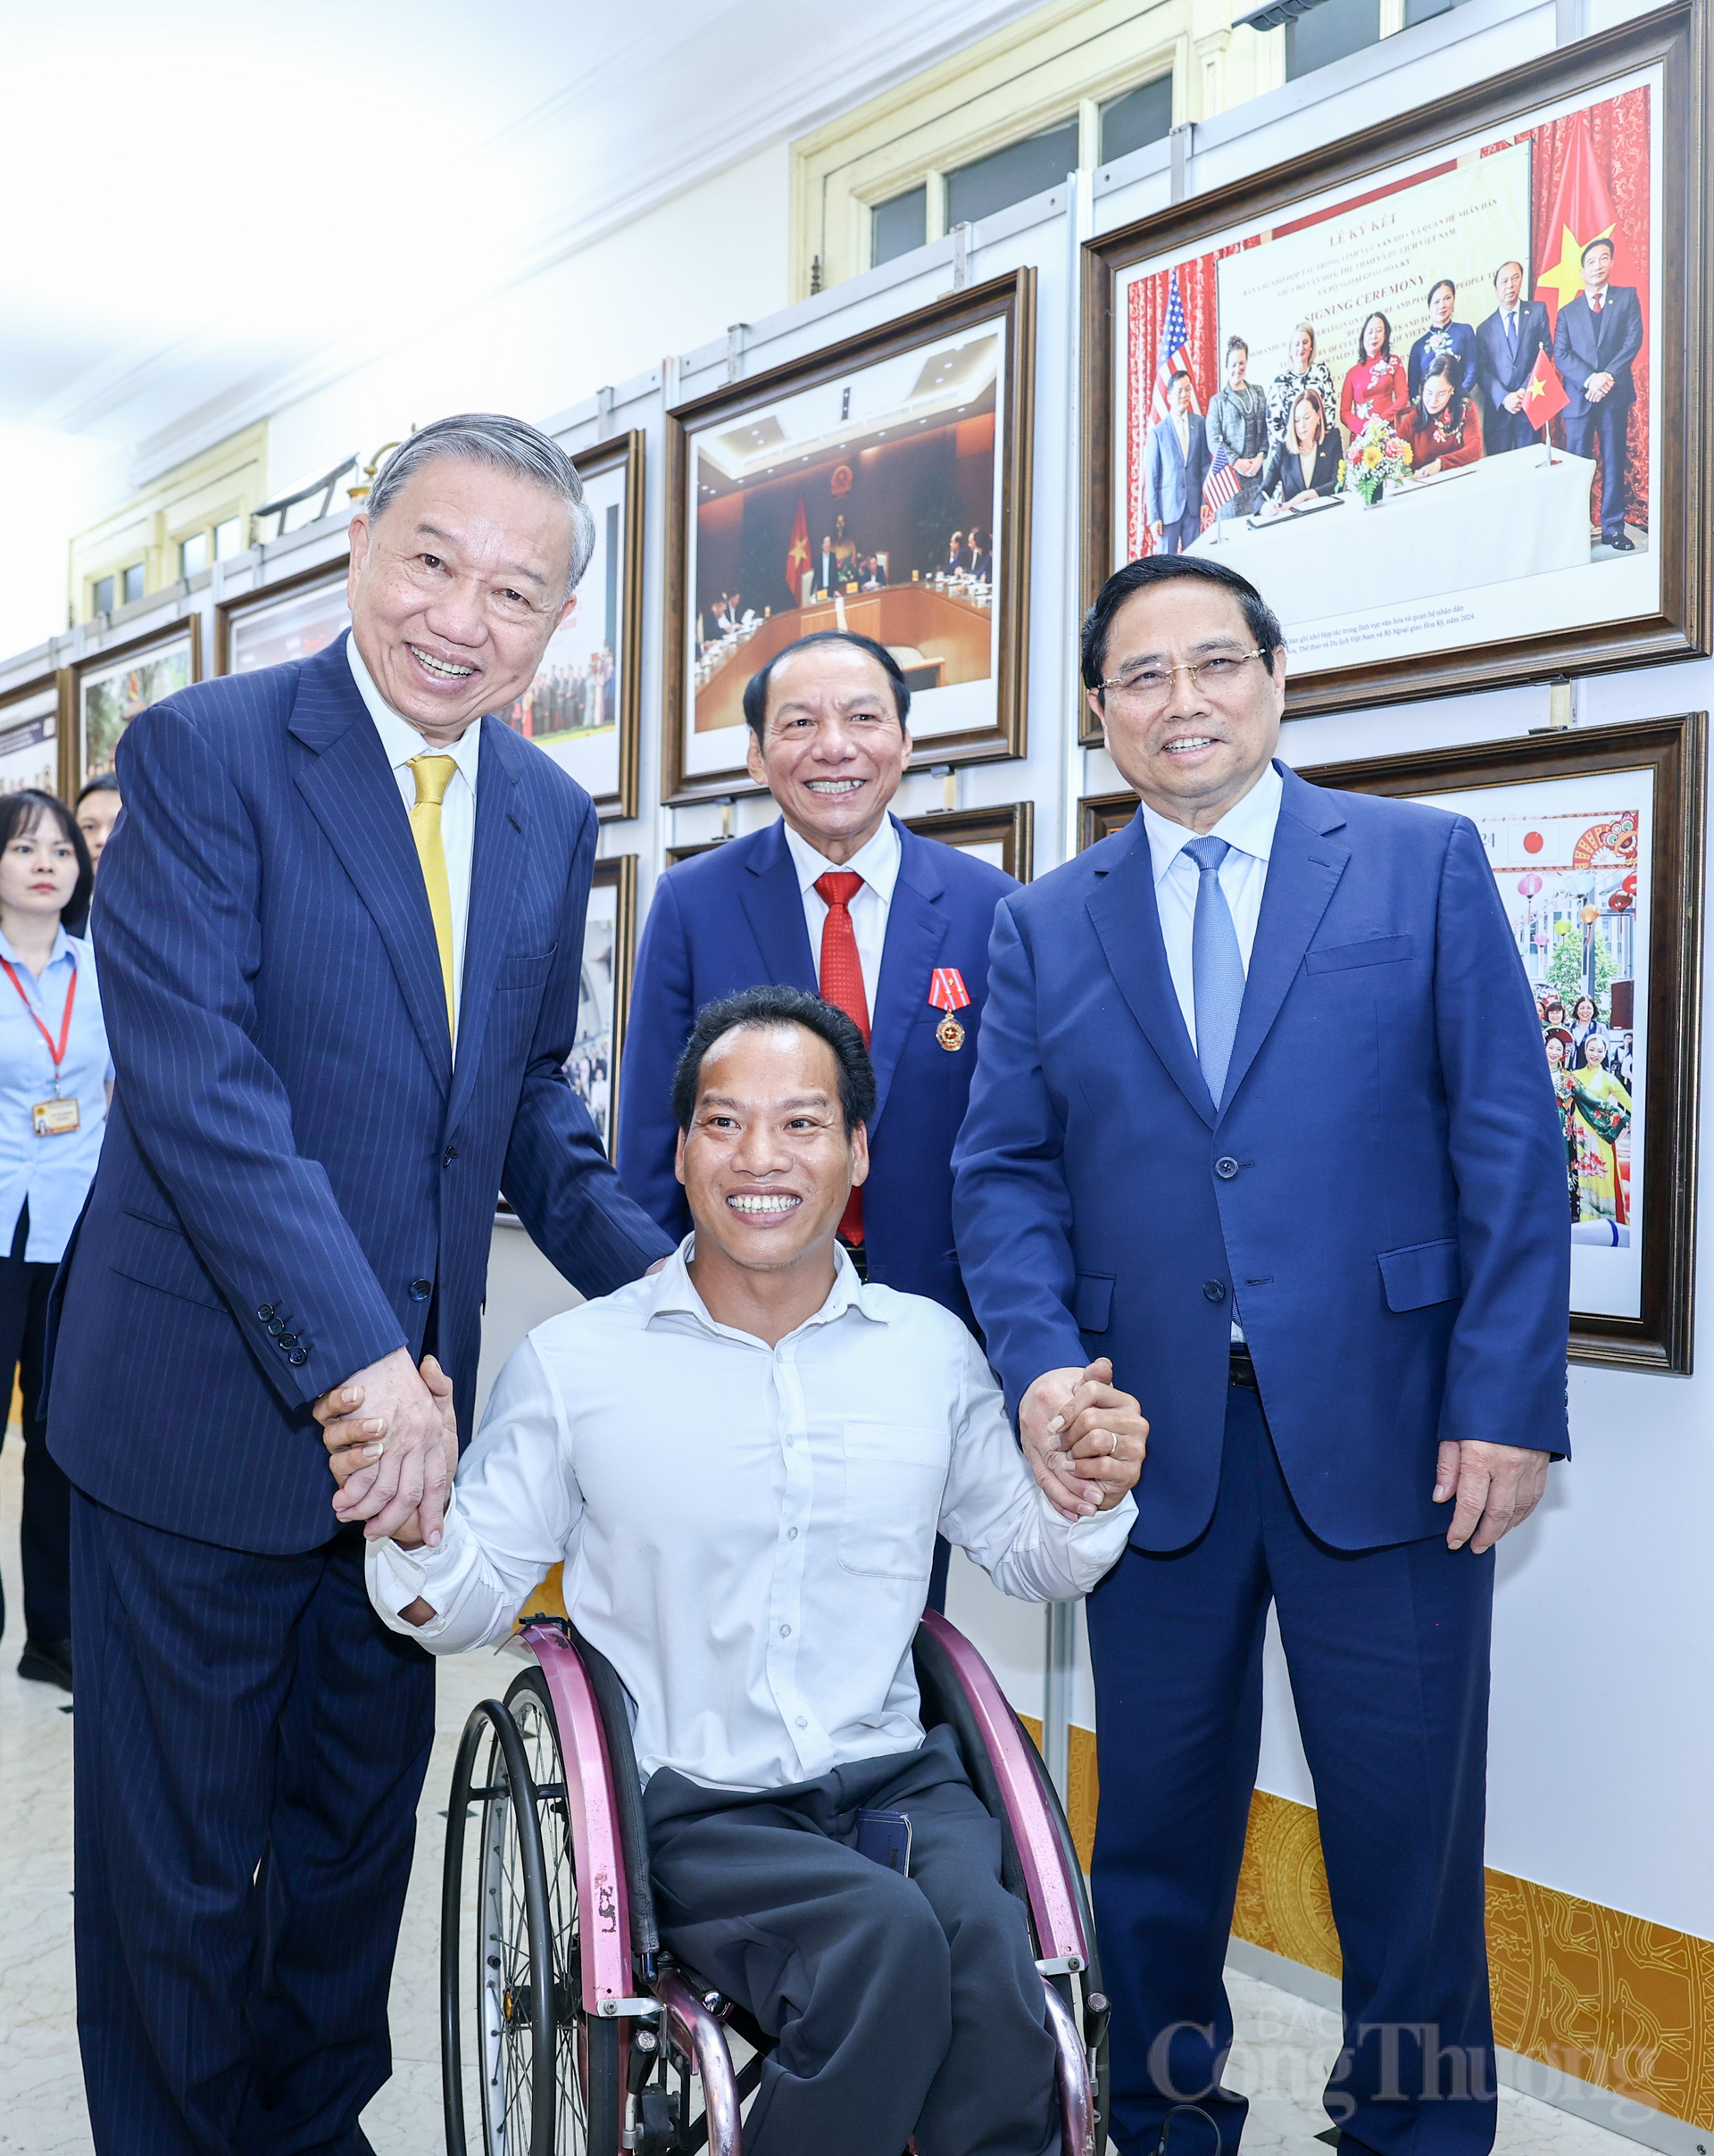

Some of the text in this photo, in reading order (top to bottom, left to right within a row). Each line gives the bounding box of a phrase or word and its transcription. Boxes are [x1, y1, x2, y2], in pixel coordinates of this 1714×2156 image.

[1303, 273, 1427, 322] SIGNING CEREMONY
[1248, 341, 1286, 357] MORANDUM
[1339, 338, 1357, 349] CULT
[1412, 613, 1427, 622] quan
[1361, 633, 1376, 641] Nam
[1410, 624, 1423, 633] giao
[1423, 621, 1435, 629] Hoa
[1446, 617, 1460, 625] năm
